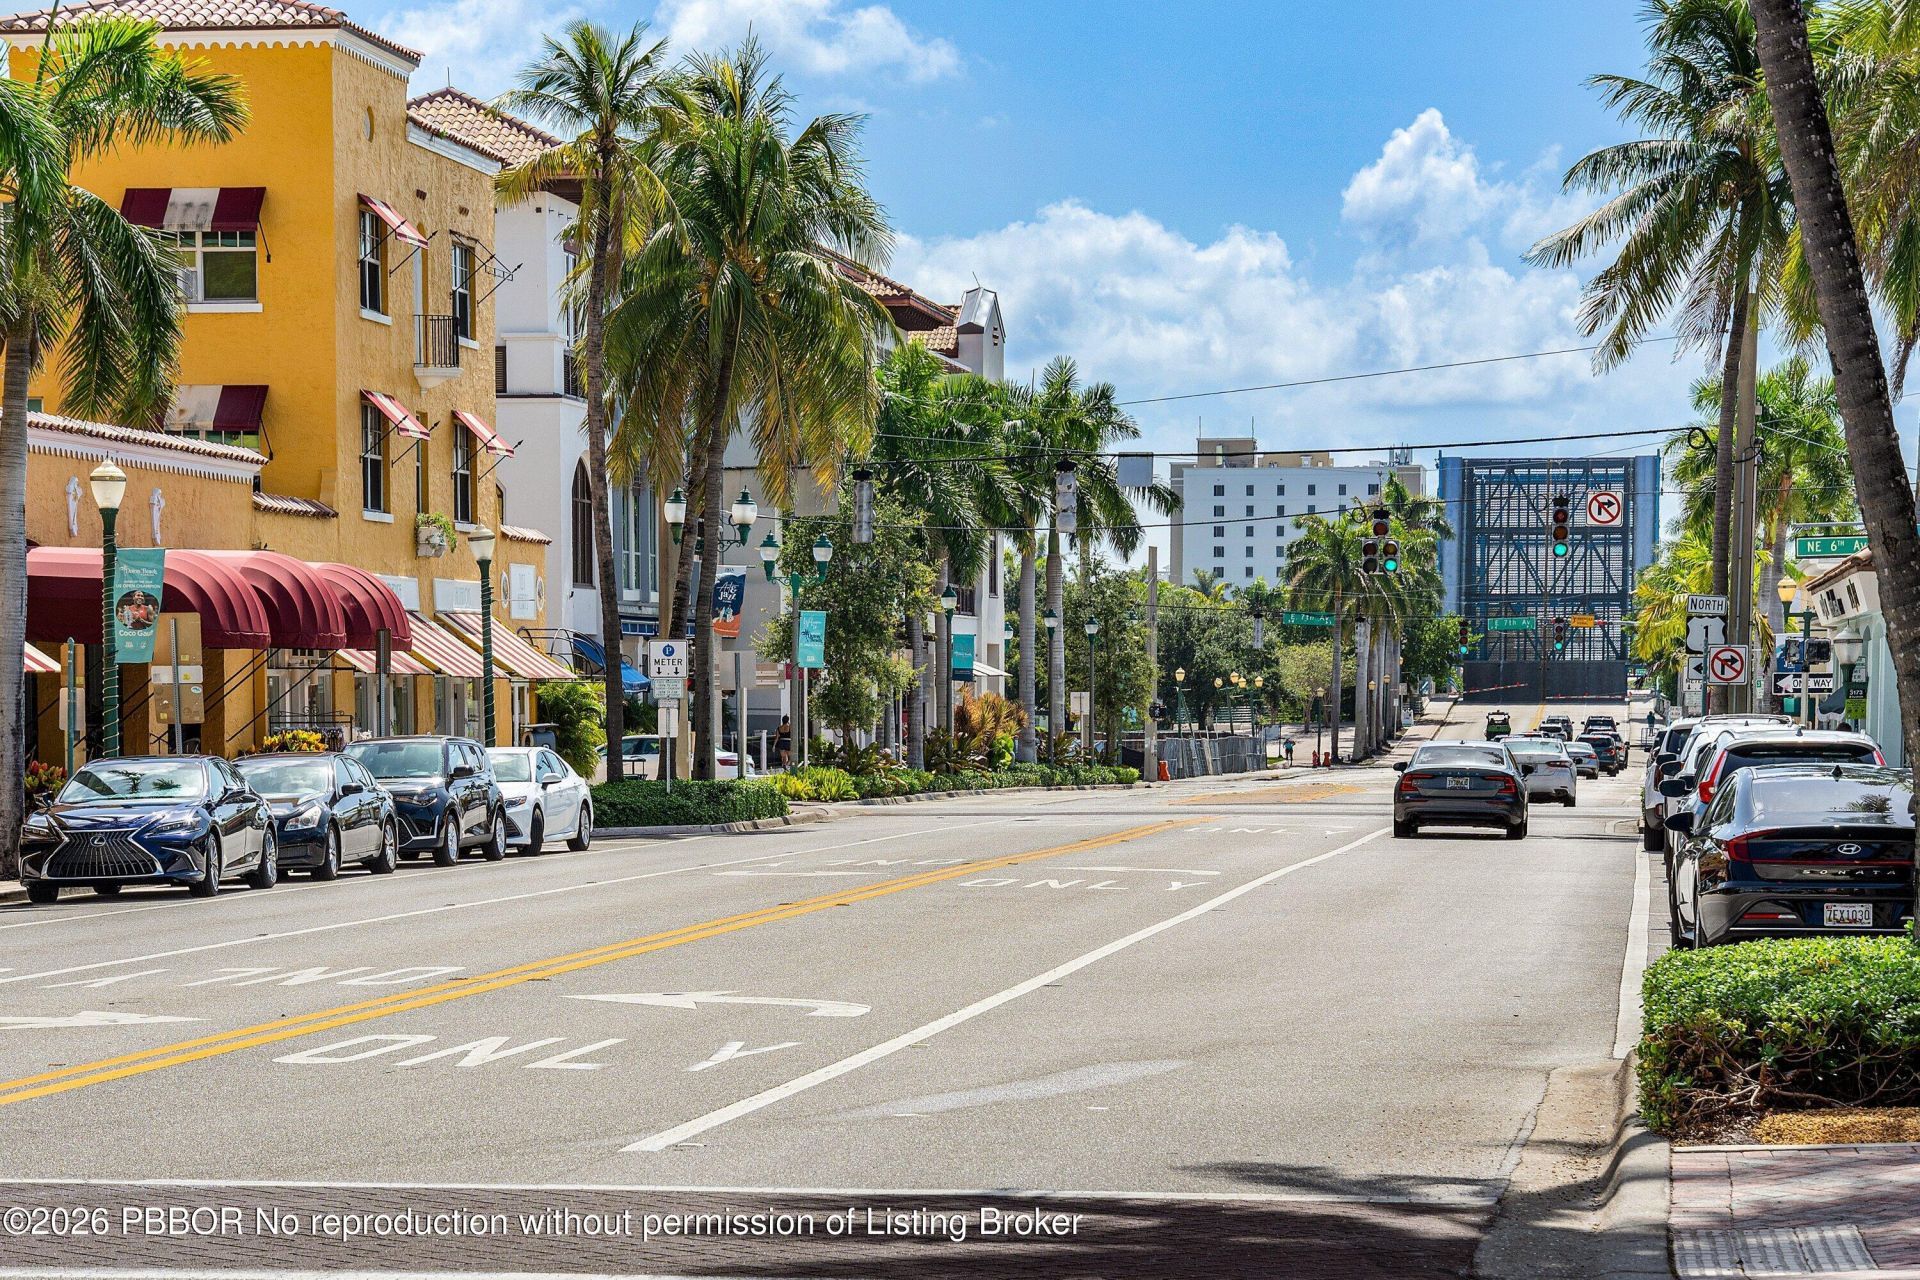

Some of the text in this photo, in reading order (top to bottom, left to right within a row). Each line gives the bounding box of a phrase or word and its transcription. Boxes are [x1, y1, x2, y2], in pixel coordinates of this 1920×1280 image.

[1807, 541, 1821, 552] NE
[1830, 540, 1844, 551] 6TH
[1690, 598, 1724, 611] NORTH
[1703, 625, 1708, 640] 1
[666, 647, 672, 655] P
[654, 658, 682, 666] METER
[1813, 679, 1831, 688] WAY
[957, 877, 1220, 892] ONLY
[271, 1034, 803, 1072] ONLY
